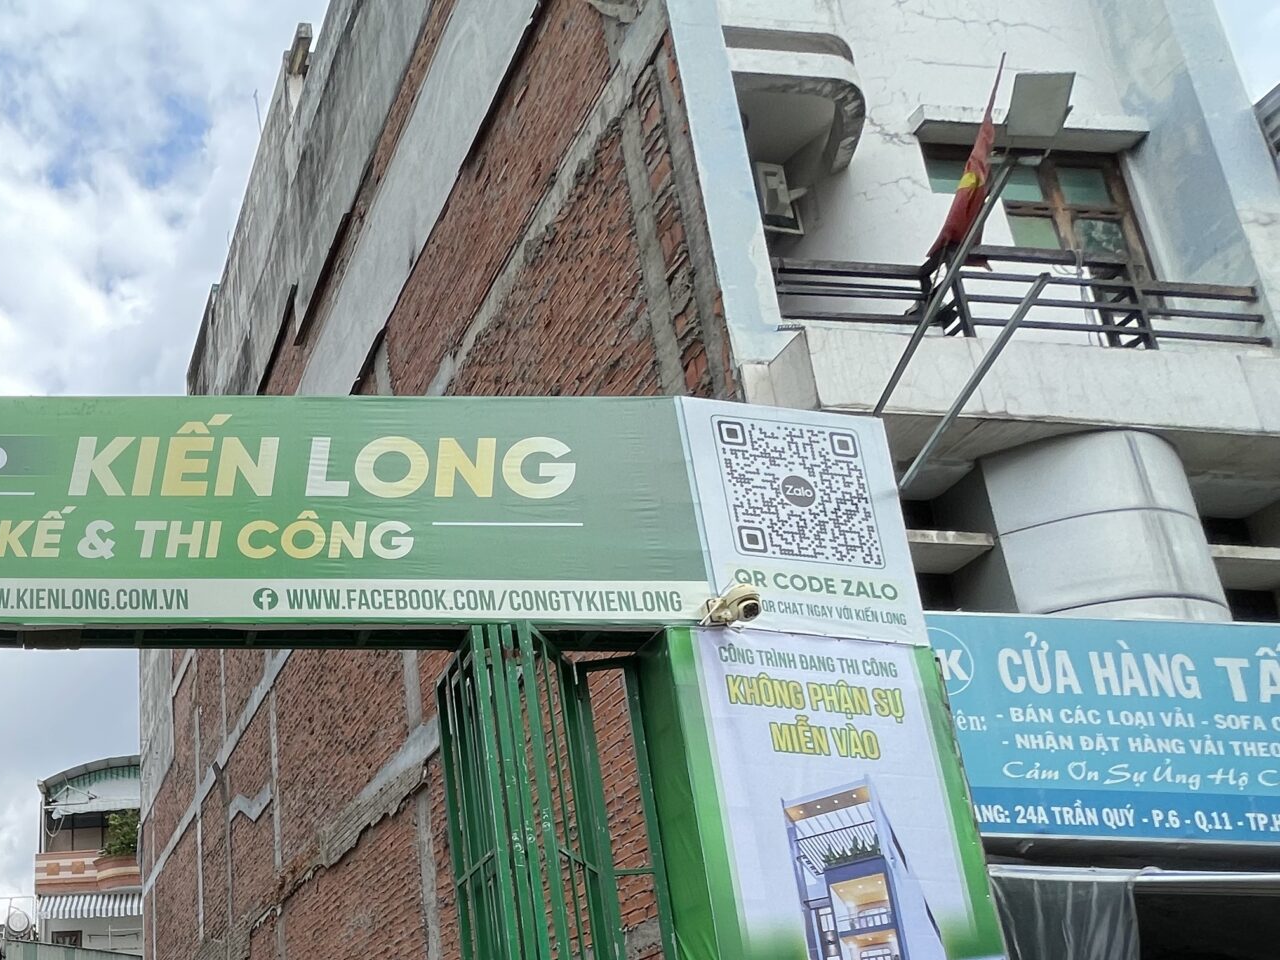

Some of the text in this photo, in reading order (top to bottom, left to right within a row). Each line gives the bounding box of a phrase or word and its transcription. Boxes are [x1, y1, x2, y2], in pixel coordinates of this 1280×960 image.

[68, 413, 280, 497] KIẾN
[304, 436, 577, 499] LONG
[785, 484, 815, 500] Zalo
[76, 521, 116, 559] &
[135, 520, 221, 558] THI
[237, 510, 414, 560] CÔNG
[287, 588, 682, 613] WWW.FACEBOOK.COM/CONGTYKIENLONG
[735, 568, 898, 601] QR CODE ZALO
[778, 601, 907, 626] CHAT NGAY VỚI KIẾN LONG
[719, 643, 898, 678] CÔNG TRÌNH ĐANG THI CÔNG
[997, 631, 1202, 699] CỬA HÀNG
[725, 673, 905, 723] KHÔNG PHẬN SỰ
[1009, 703, 1054, 723] BÁN
[1059, 705, 1102, 725] CÁC
[1107, 709, 1155, 729] LOẠI
[1160, 707, 1196, 728] VẢI
[1213, 714, 1267, 731] SOFA
[769, 714, 882, 761] MIỄN VÀO
[1015, 730, 1225, 756] NHẬN ĐẶT HÀNG VẢI
[1002, 761, 1059, 780] Cảm
[1103, 763, 1147, 787] Sự
[1207, 767, 1249, 790] Hộ
[1014, 800, 1233, 833] 24A TRẦN QUÝ P.6 Q.11
